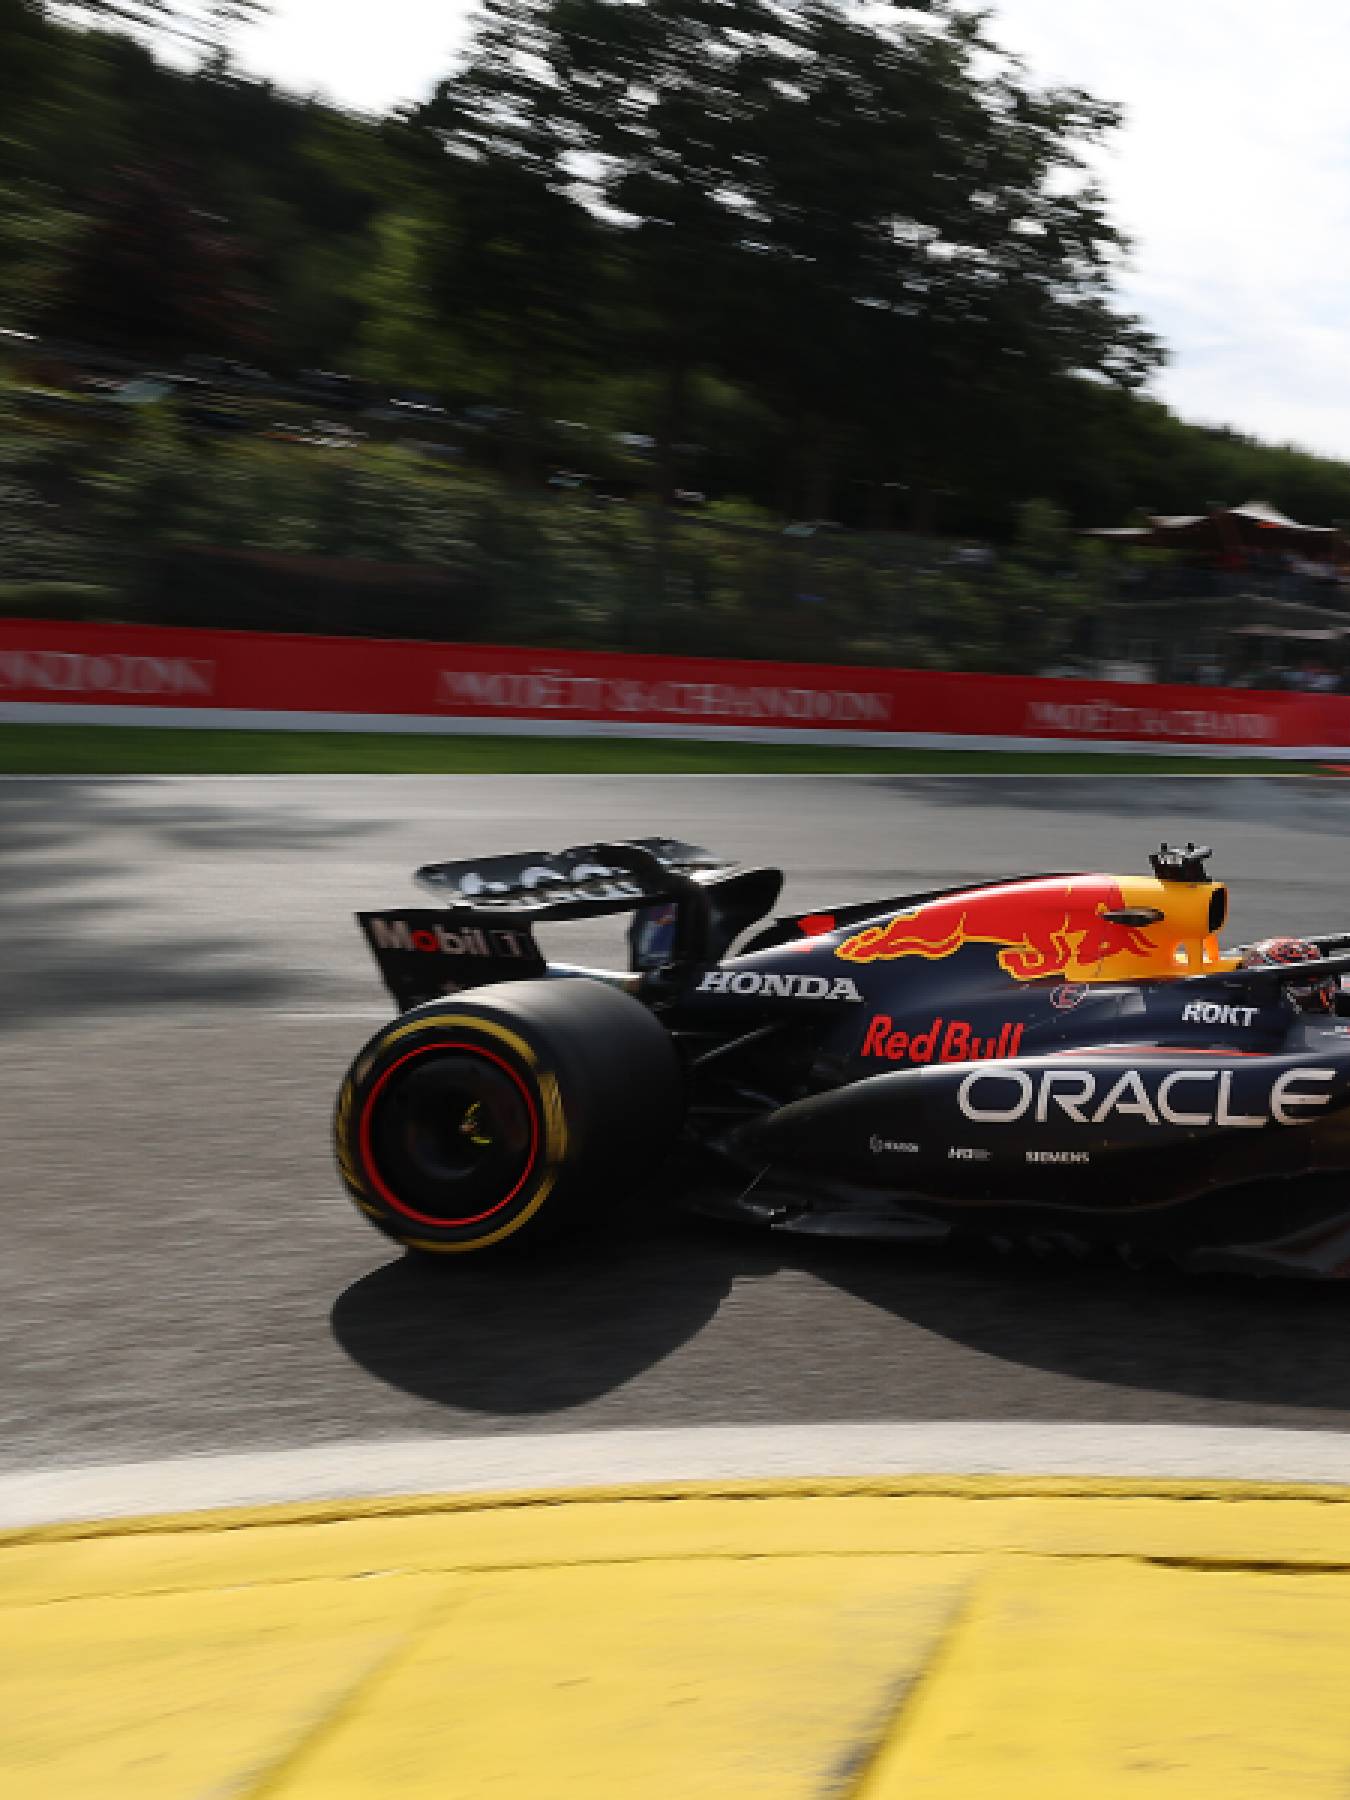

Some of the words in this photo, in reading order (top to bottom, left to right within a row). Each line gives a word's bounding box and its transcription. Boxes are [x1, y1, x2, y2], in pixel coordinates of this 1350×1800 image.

[369, 918, 490, 956] Mobil
[695, 970, 865, 1001] HONDA
[1181, 1002, 1261, 1027] ROKT
[957, 1067, 1338, 1128] ORACLE
